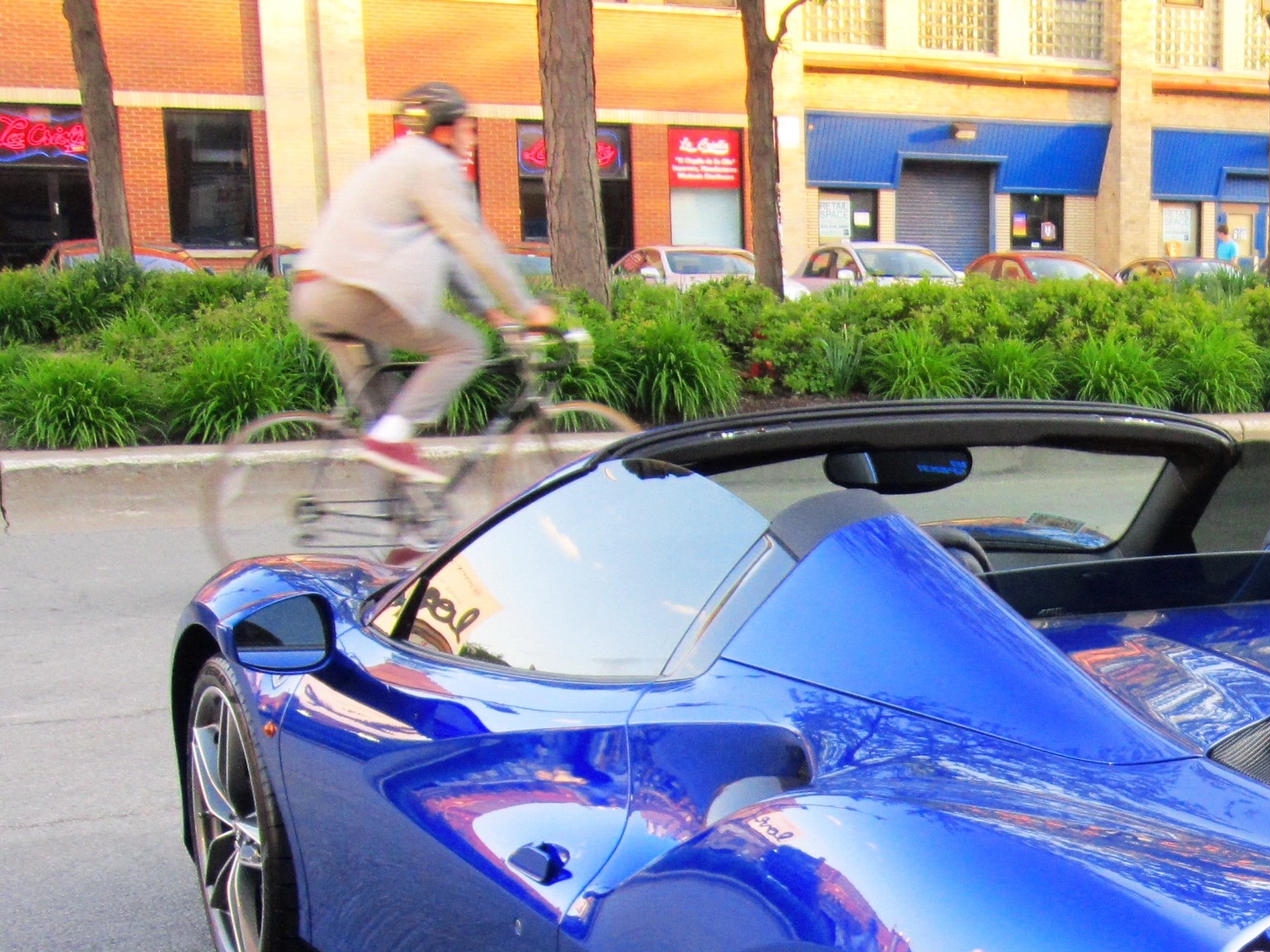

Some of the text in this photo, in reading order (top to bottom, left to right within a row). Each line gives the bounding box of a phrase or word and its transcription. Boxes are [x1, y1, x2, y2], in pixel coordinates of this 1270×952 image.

[818, 202, 848, 210] RETAIL
[819, 210, 848, 219] SPACE
[1164, 209, 1190, 217] RETAIL
[1164, 217, 1190, 226] SPACE
